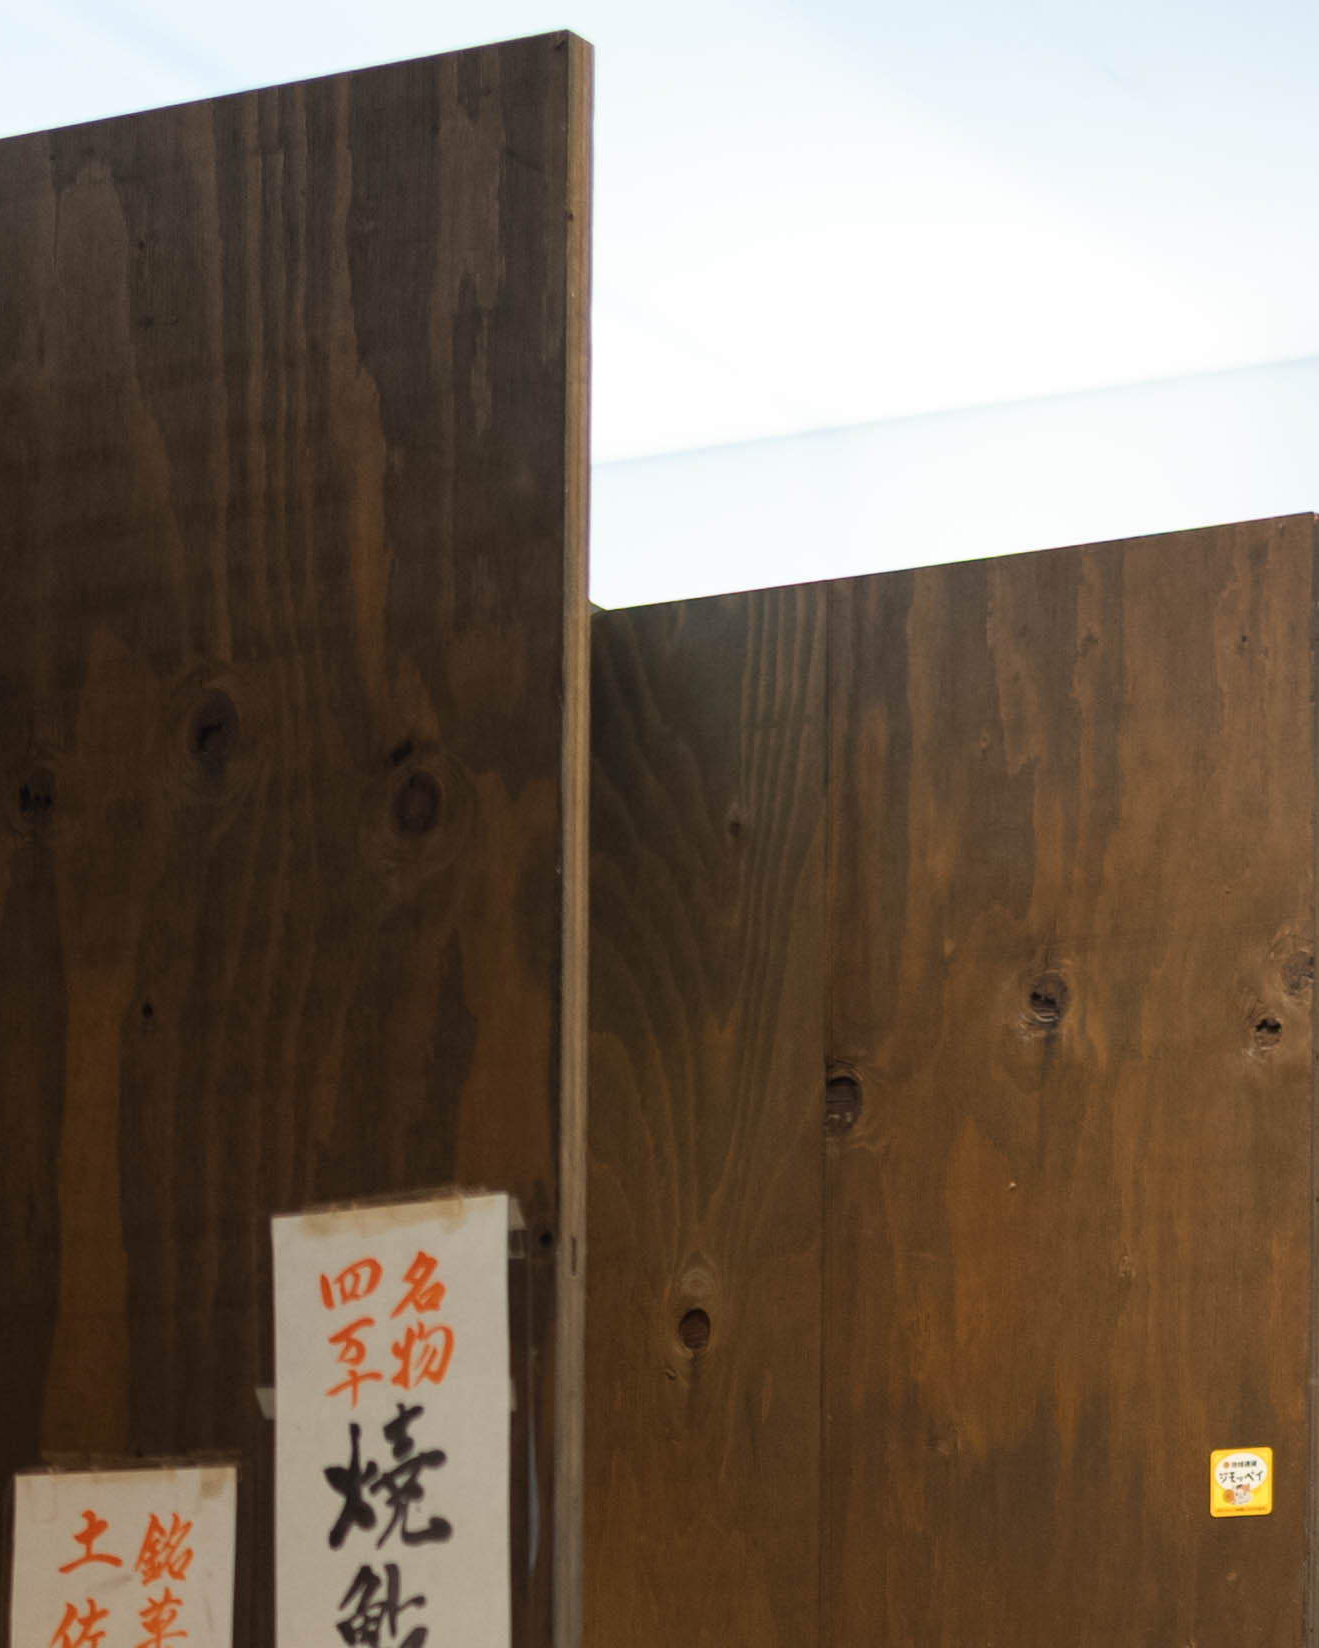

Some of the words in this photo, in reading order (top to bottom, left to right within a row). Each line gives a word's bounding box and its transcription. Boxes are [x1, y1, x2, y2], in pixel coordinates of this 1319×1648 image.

[318, 1256, 385, 1408] 四万十
[390, 1248, 455, 1391] 名物
